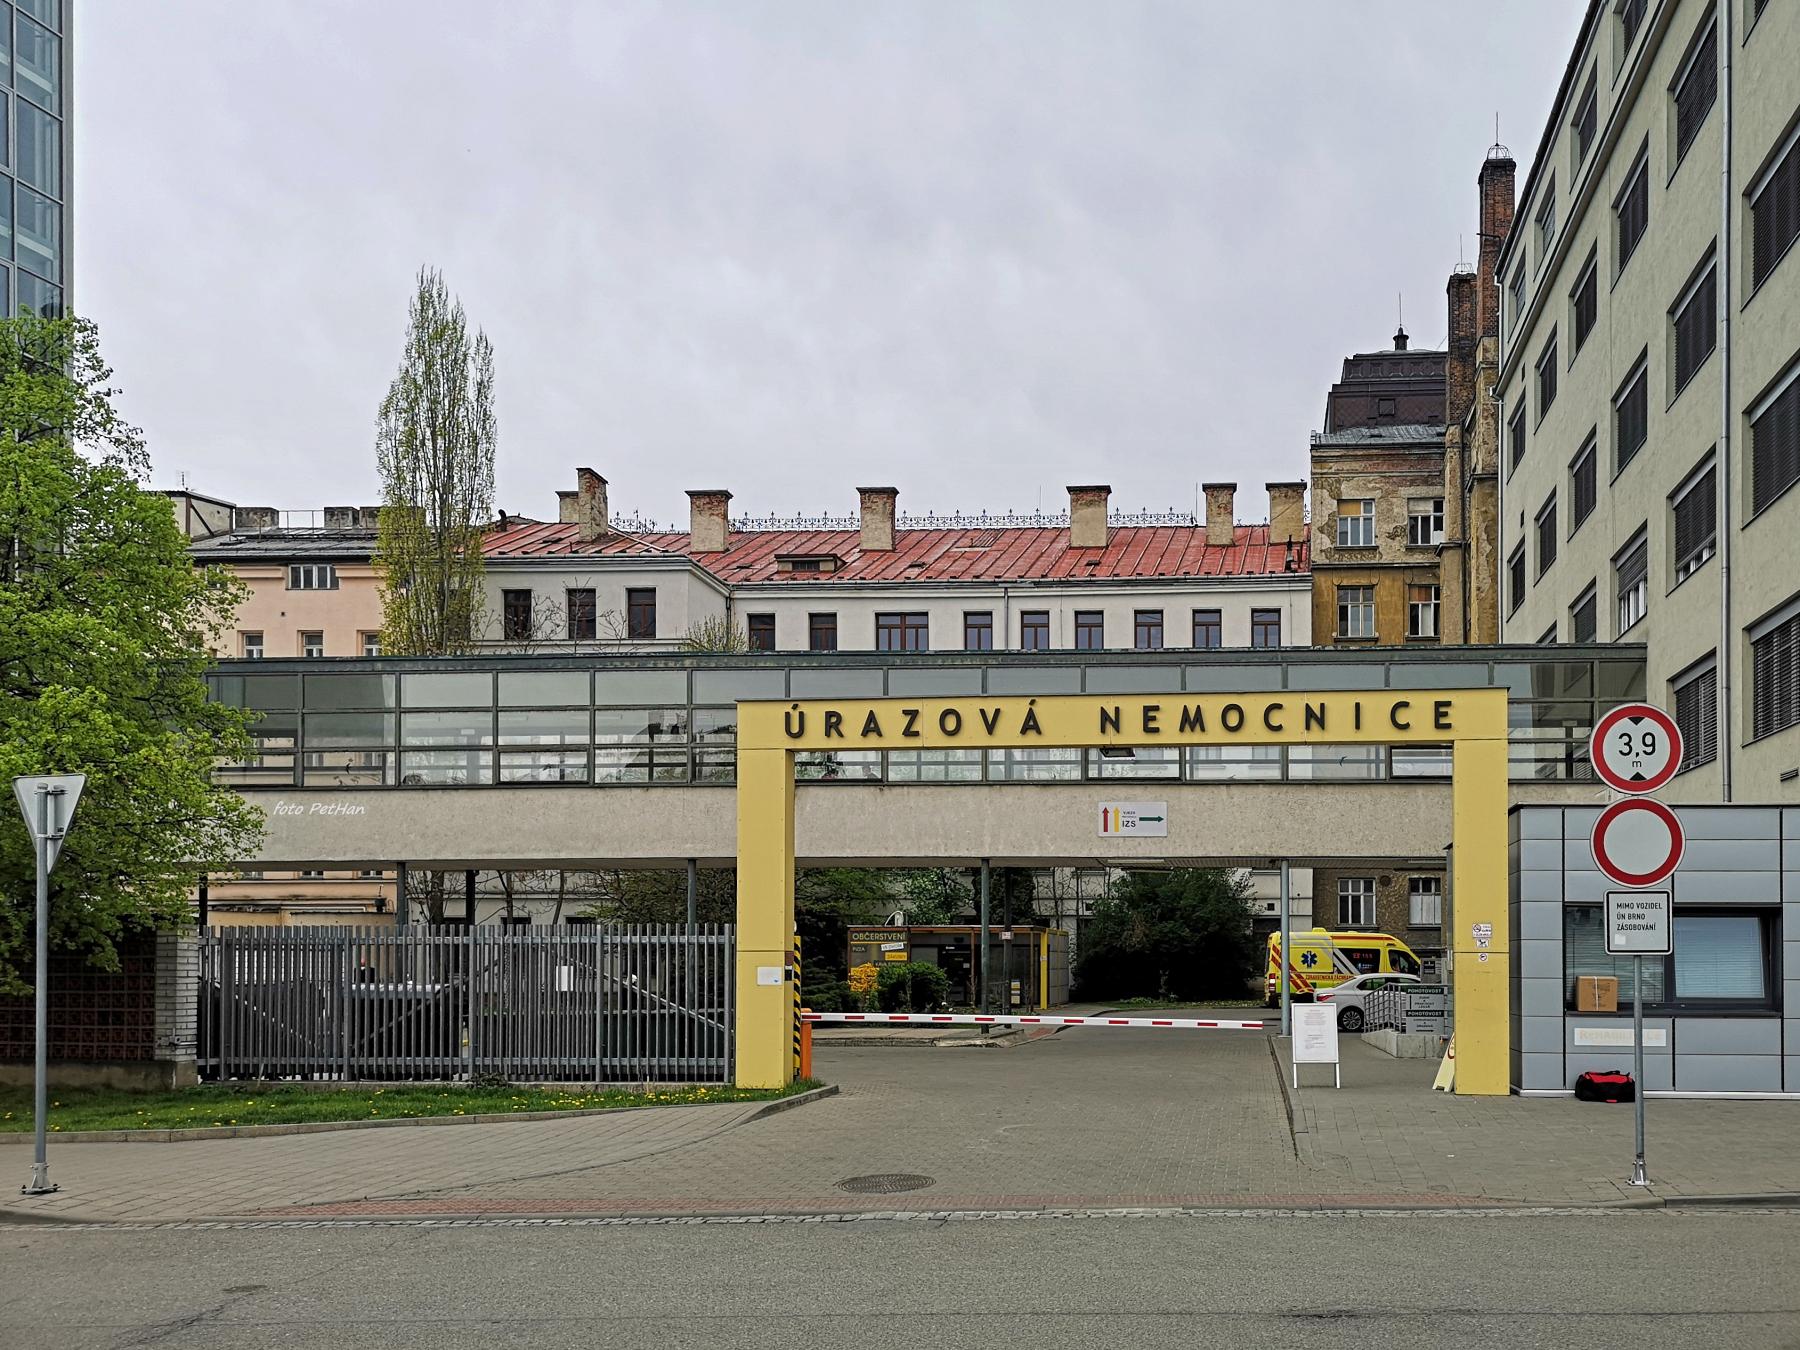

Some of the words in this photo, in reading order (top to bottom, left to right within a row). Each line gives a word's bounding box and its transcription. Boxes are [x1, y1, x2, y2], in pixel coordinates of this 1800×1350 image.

[784, 699, 1042, 739] ÚRAZOVÁ
[1100, 700, 1452, 735] NEMOCNICE
[1618, 731, 1656, 758] 3,9
[1632, 760, 1642, 768] m
[1122, 820, 1136, 828] IZS
[1616, 902, 1635, 910] MIMO
[1636, 902, 1663, 910] VOZIDEL
[1627, 912, 1646, 920] BRNO
[1616, 922, 1656, 931] ZÁSOBOVÁNÍ
[852, 932, 906, 940] OBČERSTVENÍ
